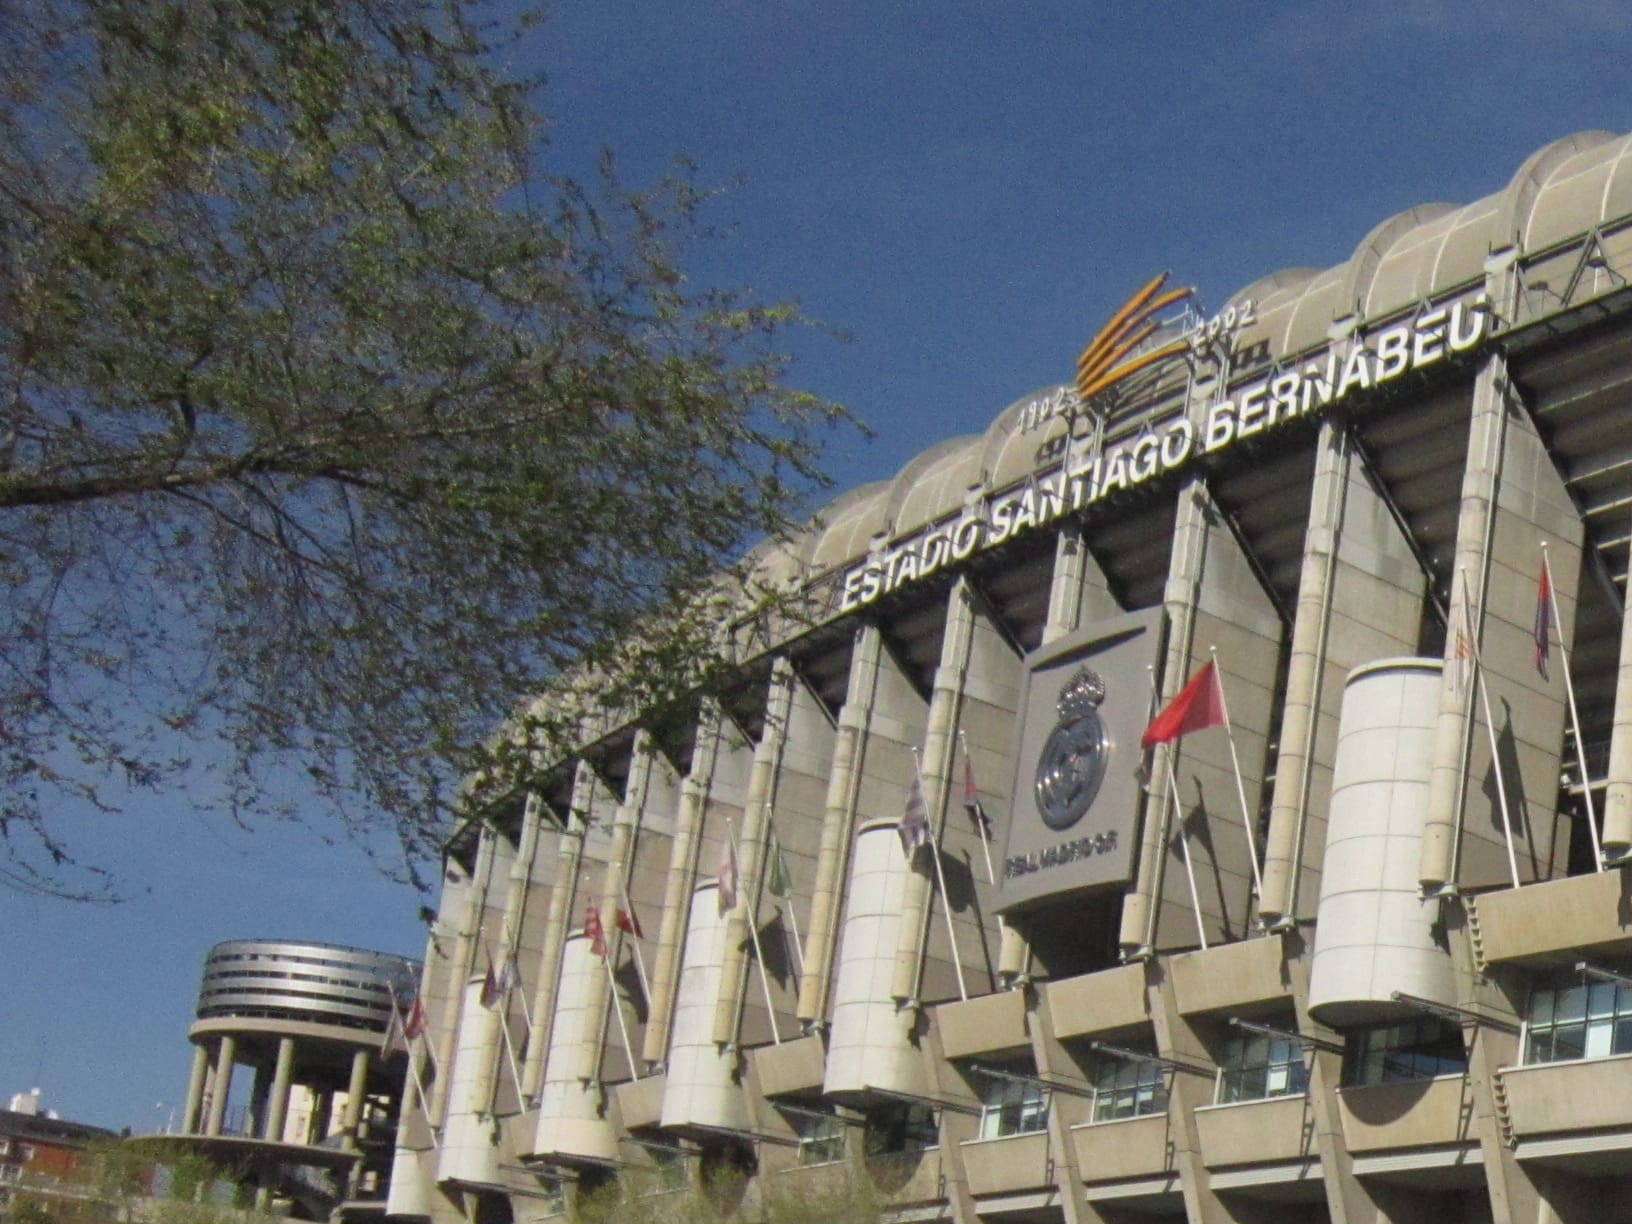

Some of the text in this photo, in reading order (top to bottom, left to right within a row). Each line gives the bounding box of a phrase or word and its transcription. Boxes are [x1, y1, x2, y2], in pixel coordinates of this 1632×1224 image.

[1194, 298, 1257, 346] 2002
[840, 294, 1489, 613] ESTADIO SANTIAGO BERNABEU
